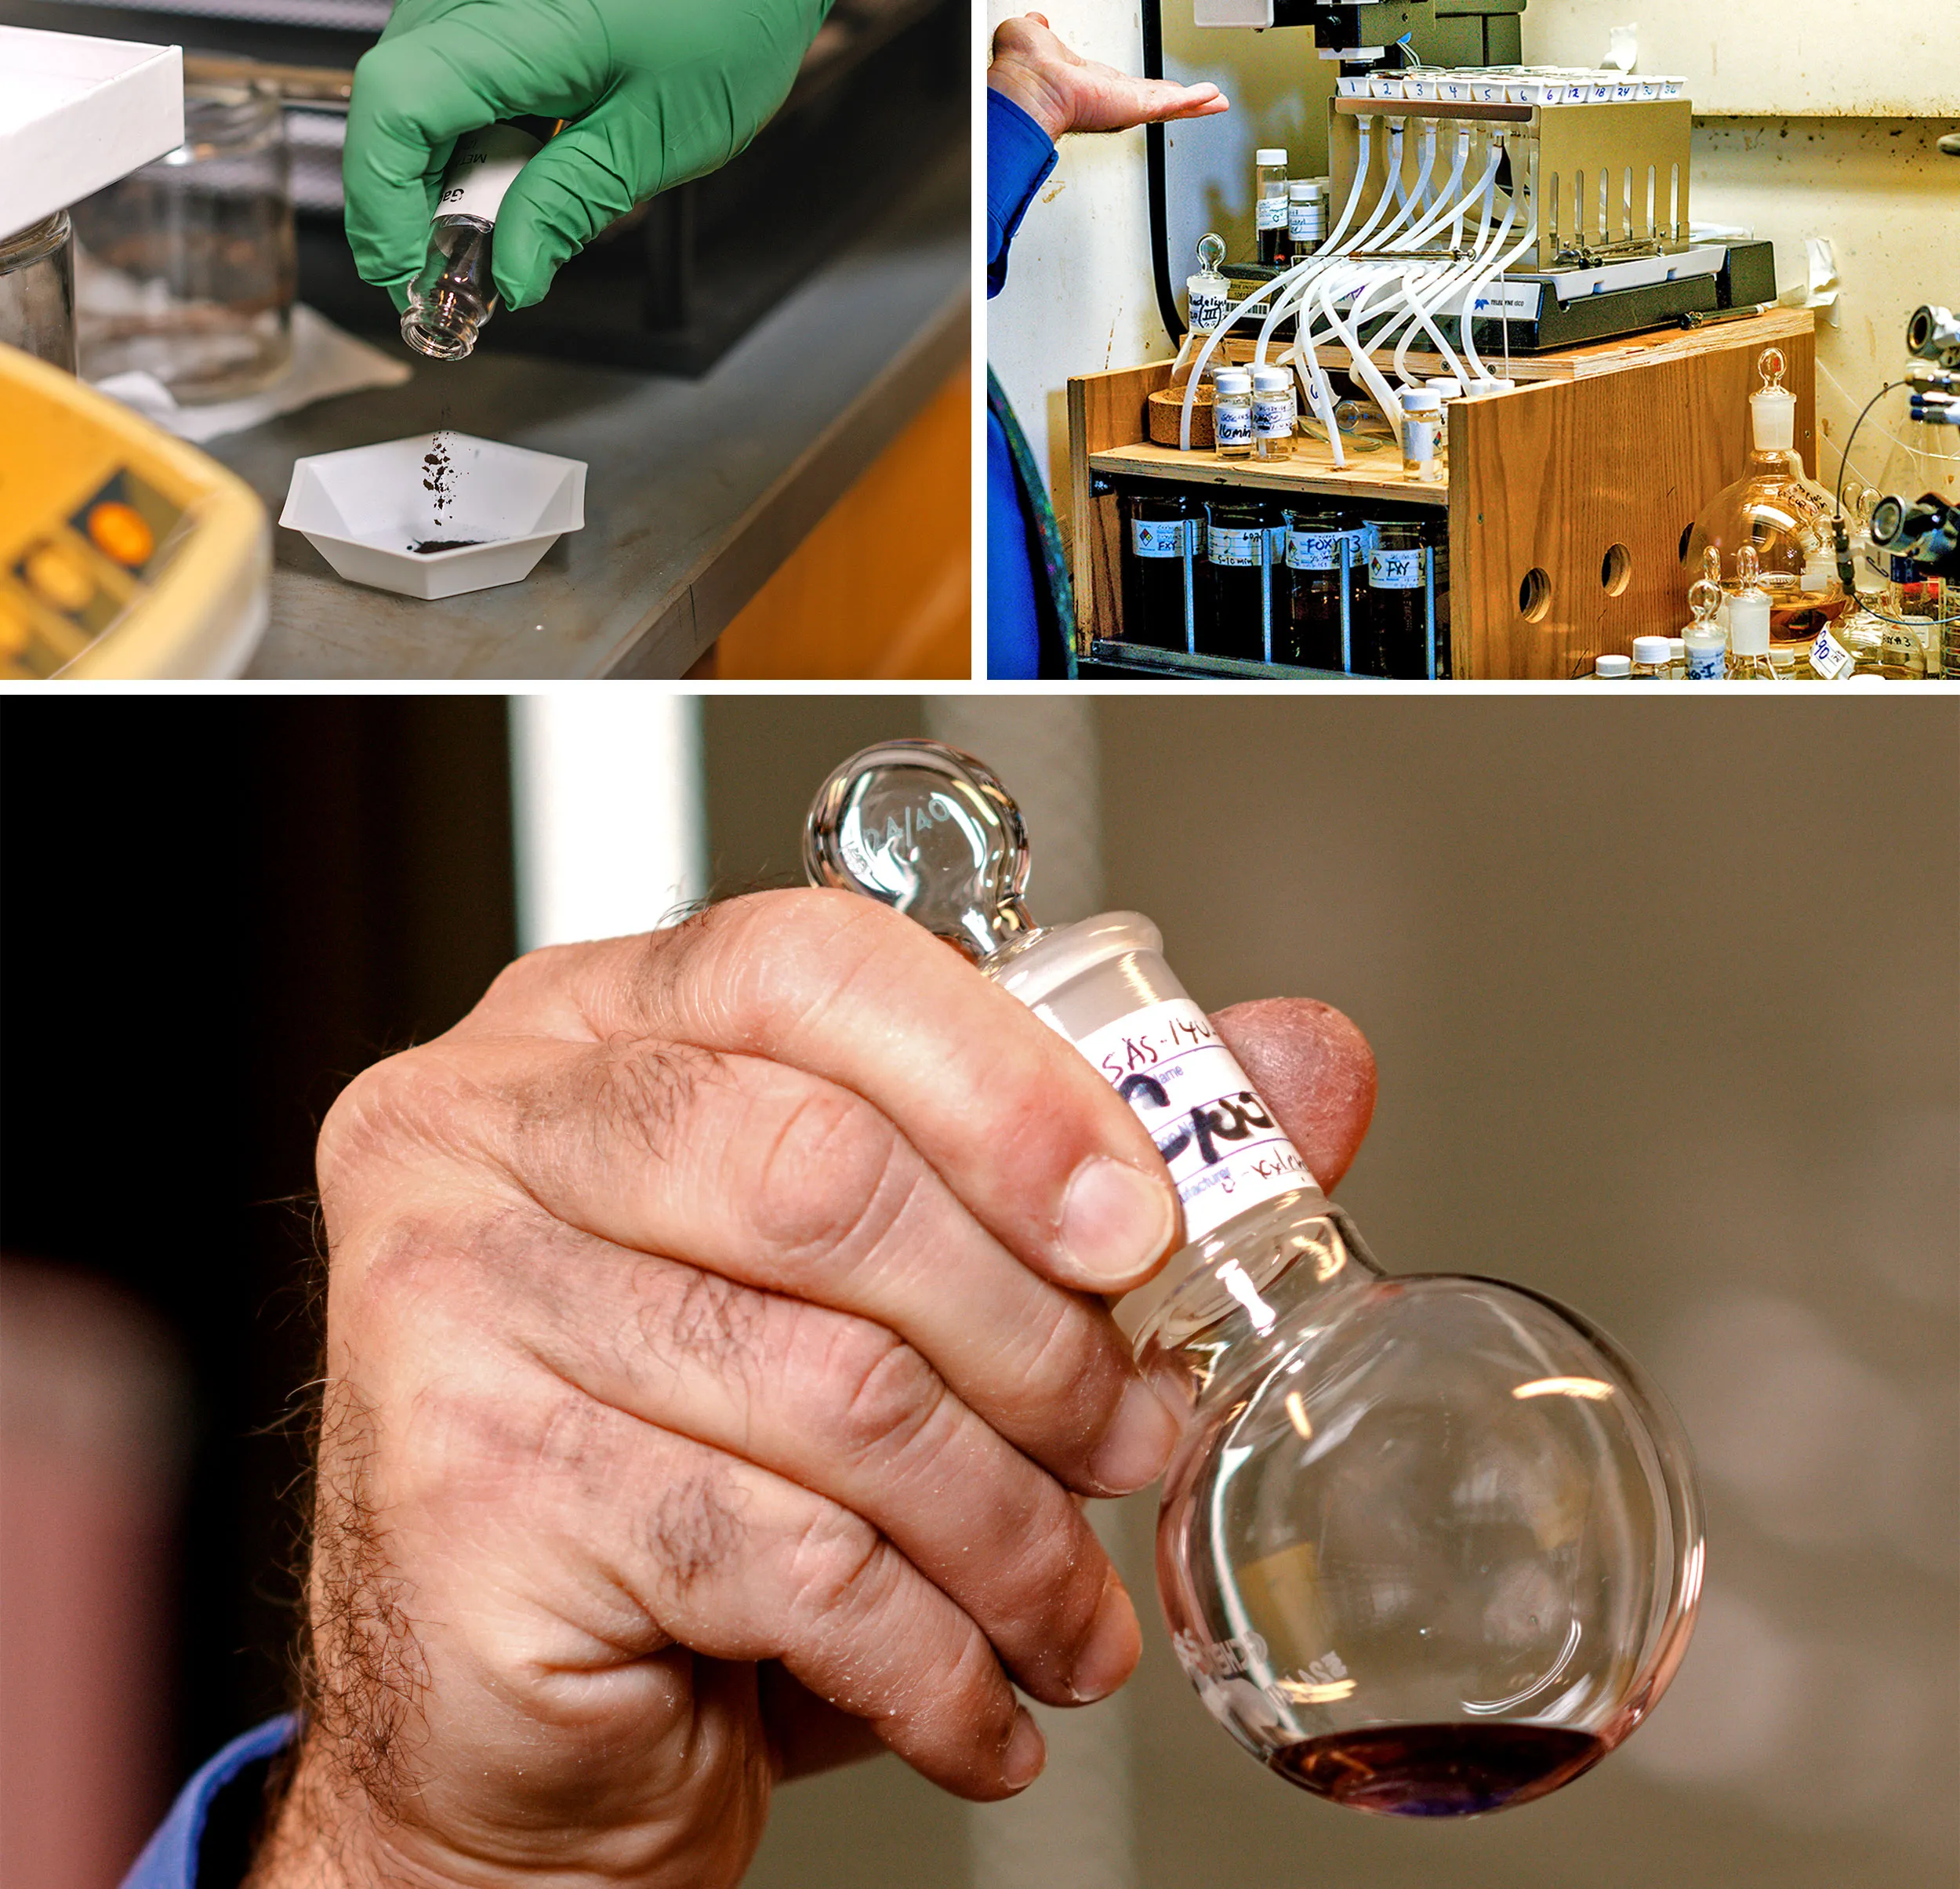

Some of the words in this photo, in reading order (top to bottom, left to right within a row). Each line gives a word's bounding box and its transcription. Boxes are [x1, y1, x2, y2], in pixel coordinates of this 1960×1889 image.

[1351, 80, 1356, 93] 1
[1383, 82, 1392, 95] 2
[1416, 83, 1424, 96] 3
[1449, 85, 1457, 98] 4
[1484, 89, 1492, 101] 5
[1519, 89, 1528, 102] 6
[1546, 89, 1553, 100] 6
[1567, 87, 1580, 99] 12
[1595, 87, 1606, 97] 18
[1617, 86, 1630, 97] 24
